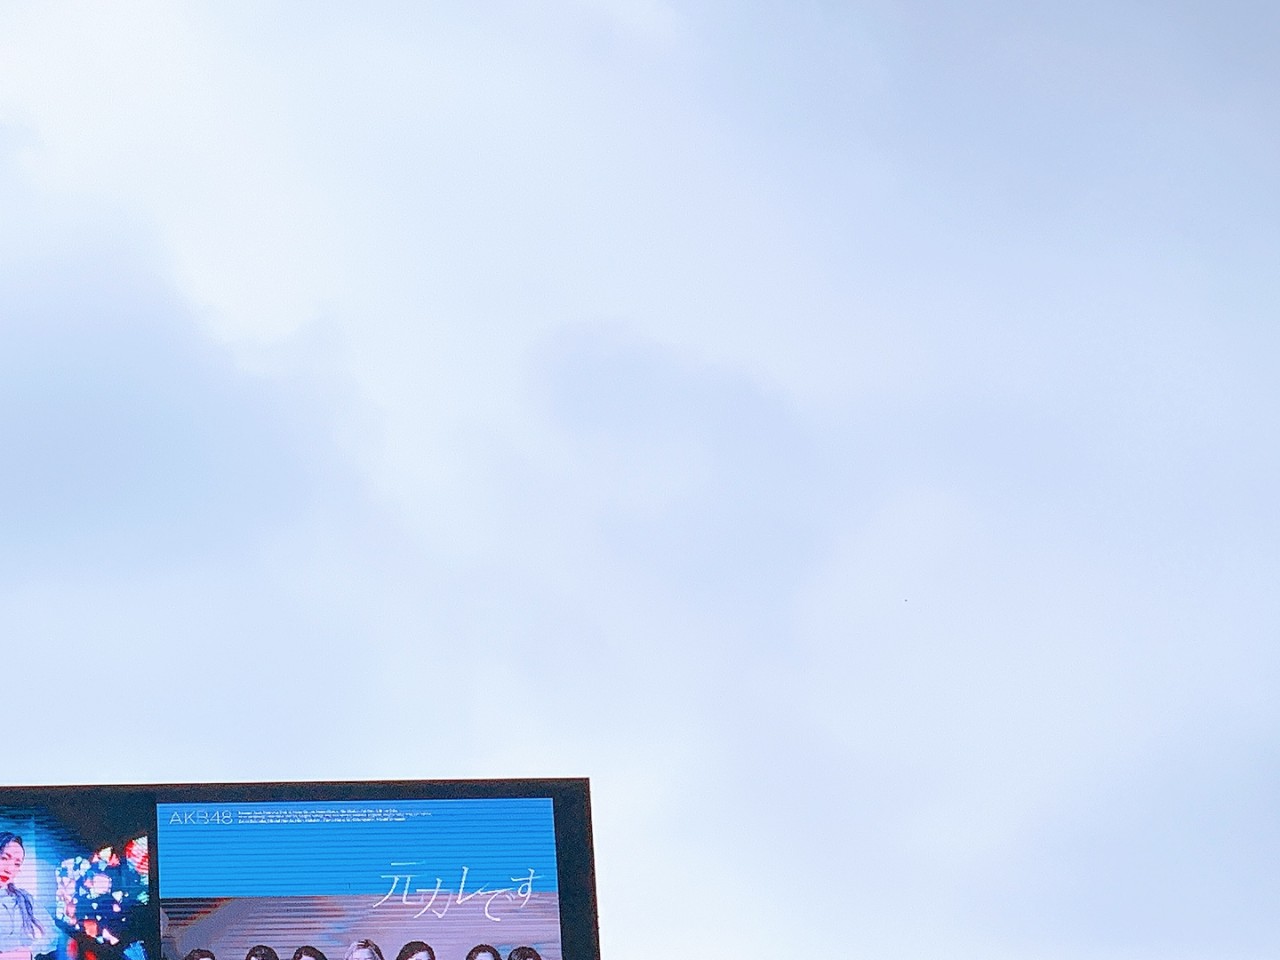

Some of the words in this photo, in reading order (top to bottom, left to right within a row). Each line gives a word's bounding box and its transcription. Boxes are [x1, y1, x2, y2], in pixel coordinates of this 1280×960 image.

[169, 810, 233, 825] AKB48
[372, 861, 545, 922] 元カレです
